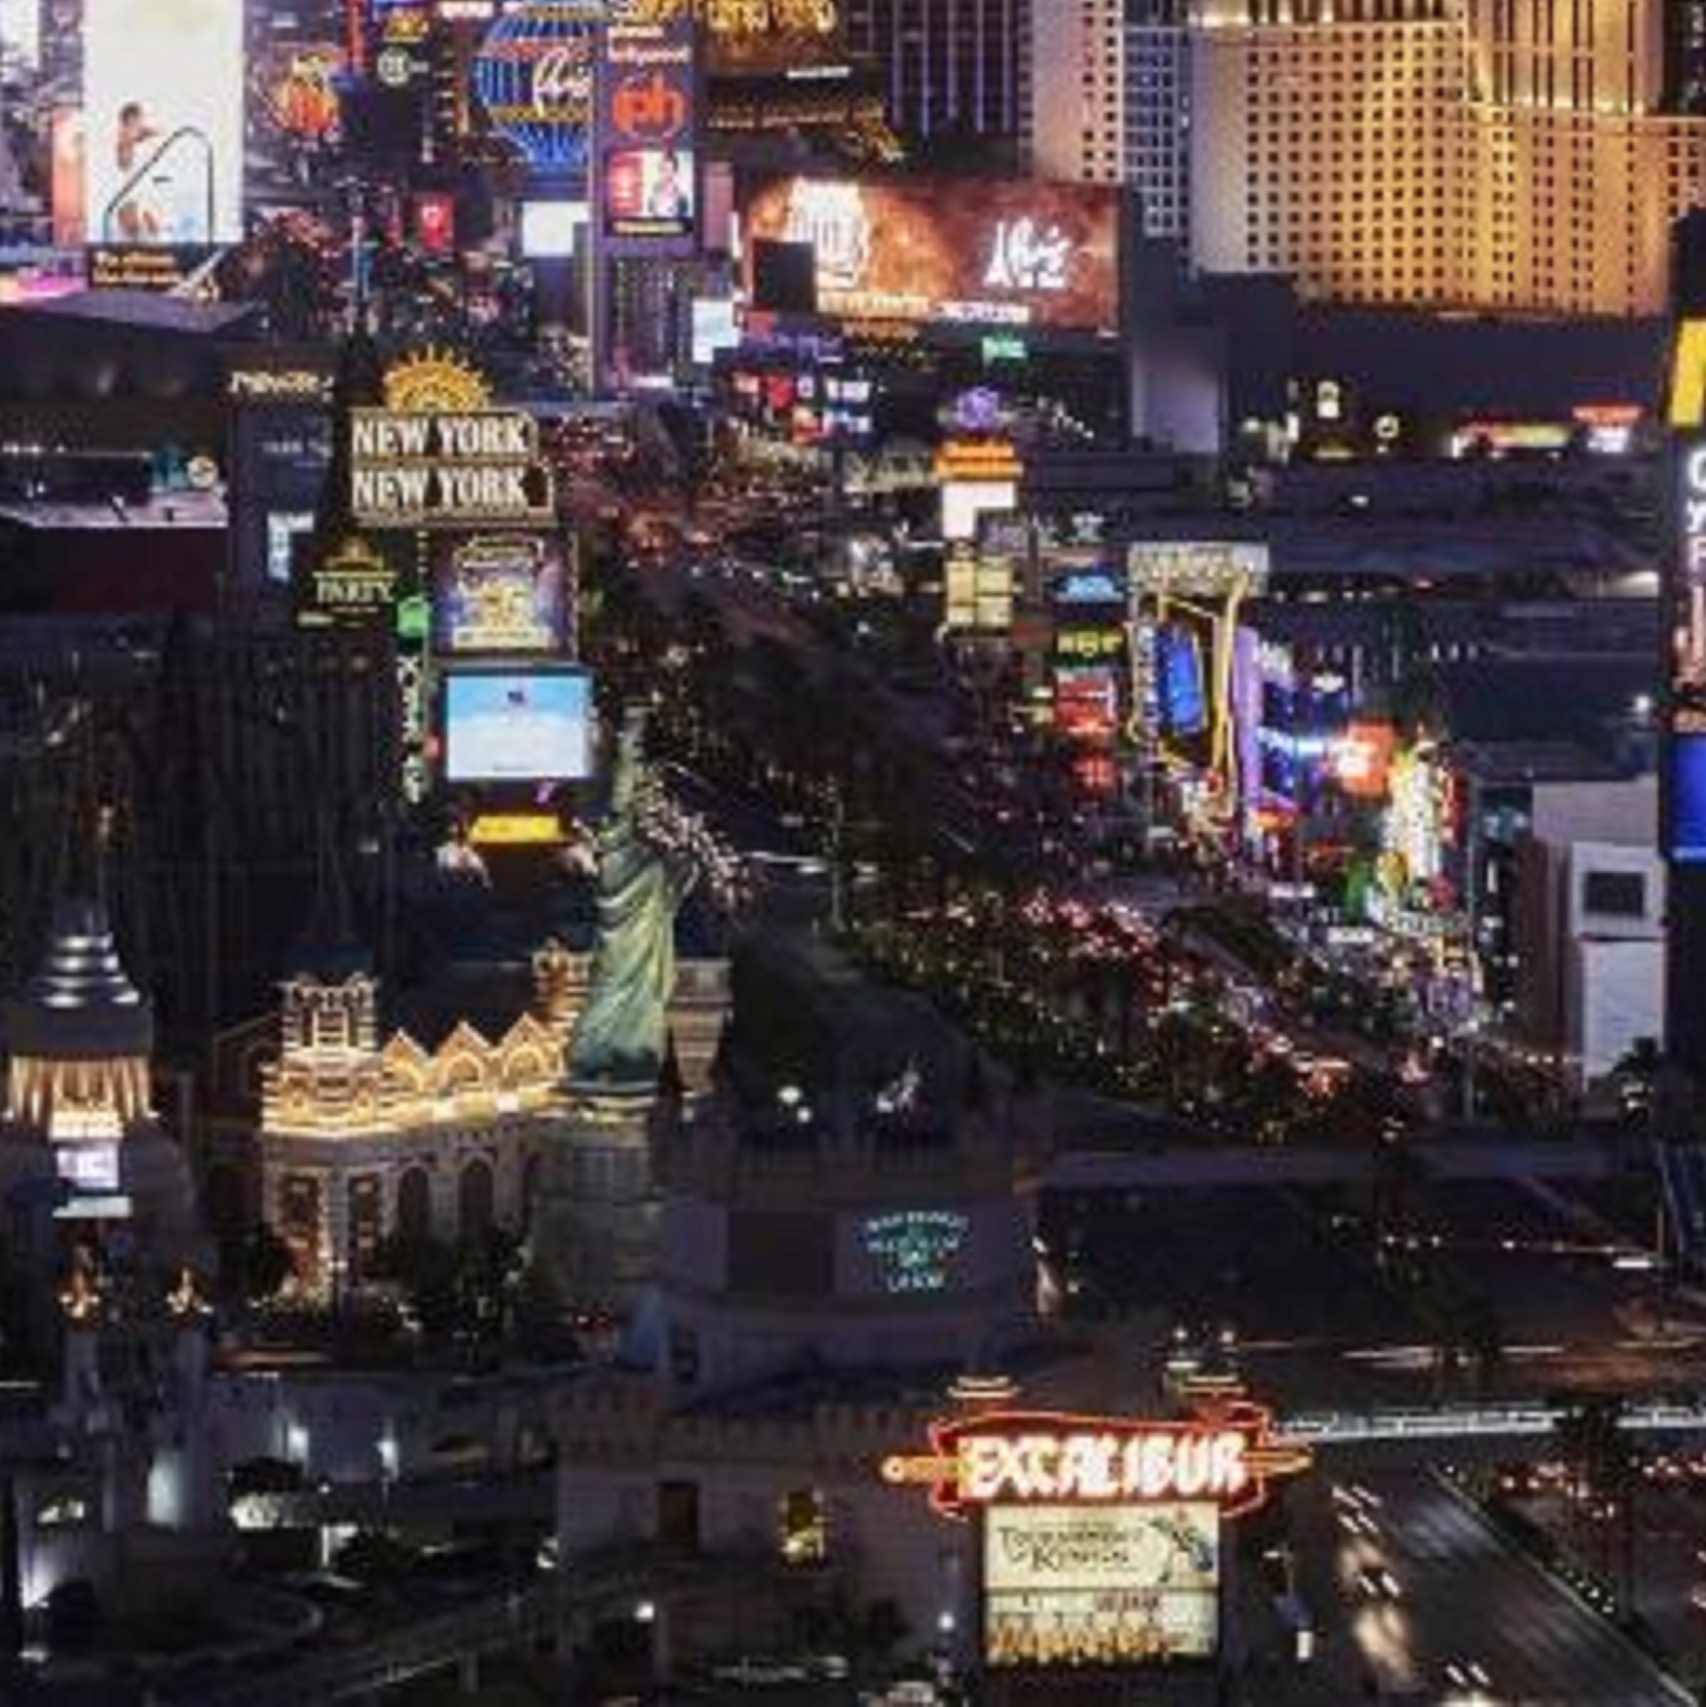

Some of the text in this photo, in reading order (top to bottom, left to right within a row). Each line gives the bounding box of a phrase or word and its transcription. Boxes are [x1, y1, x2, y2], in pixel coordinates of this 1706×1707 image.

[352, 416, 430, 454] NEW
[437, 416, 528, 454] YORK
[352, 466, 528, 509] NEW YORK
[964, 1435, 1249, 1499] EXCALIBUR
